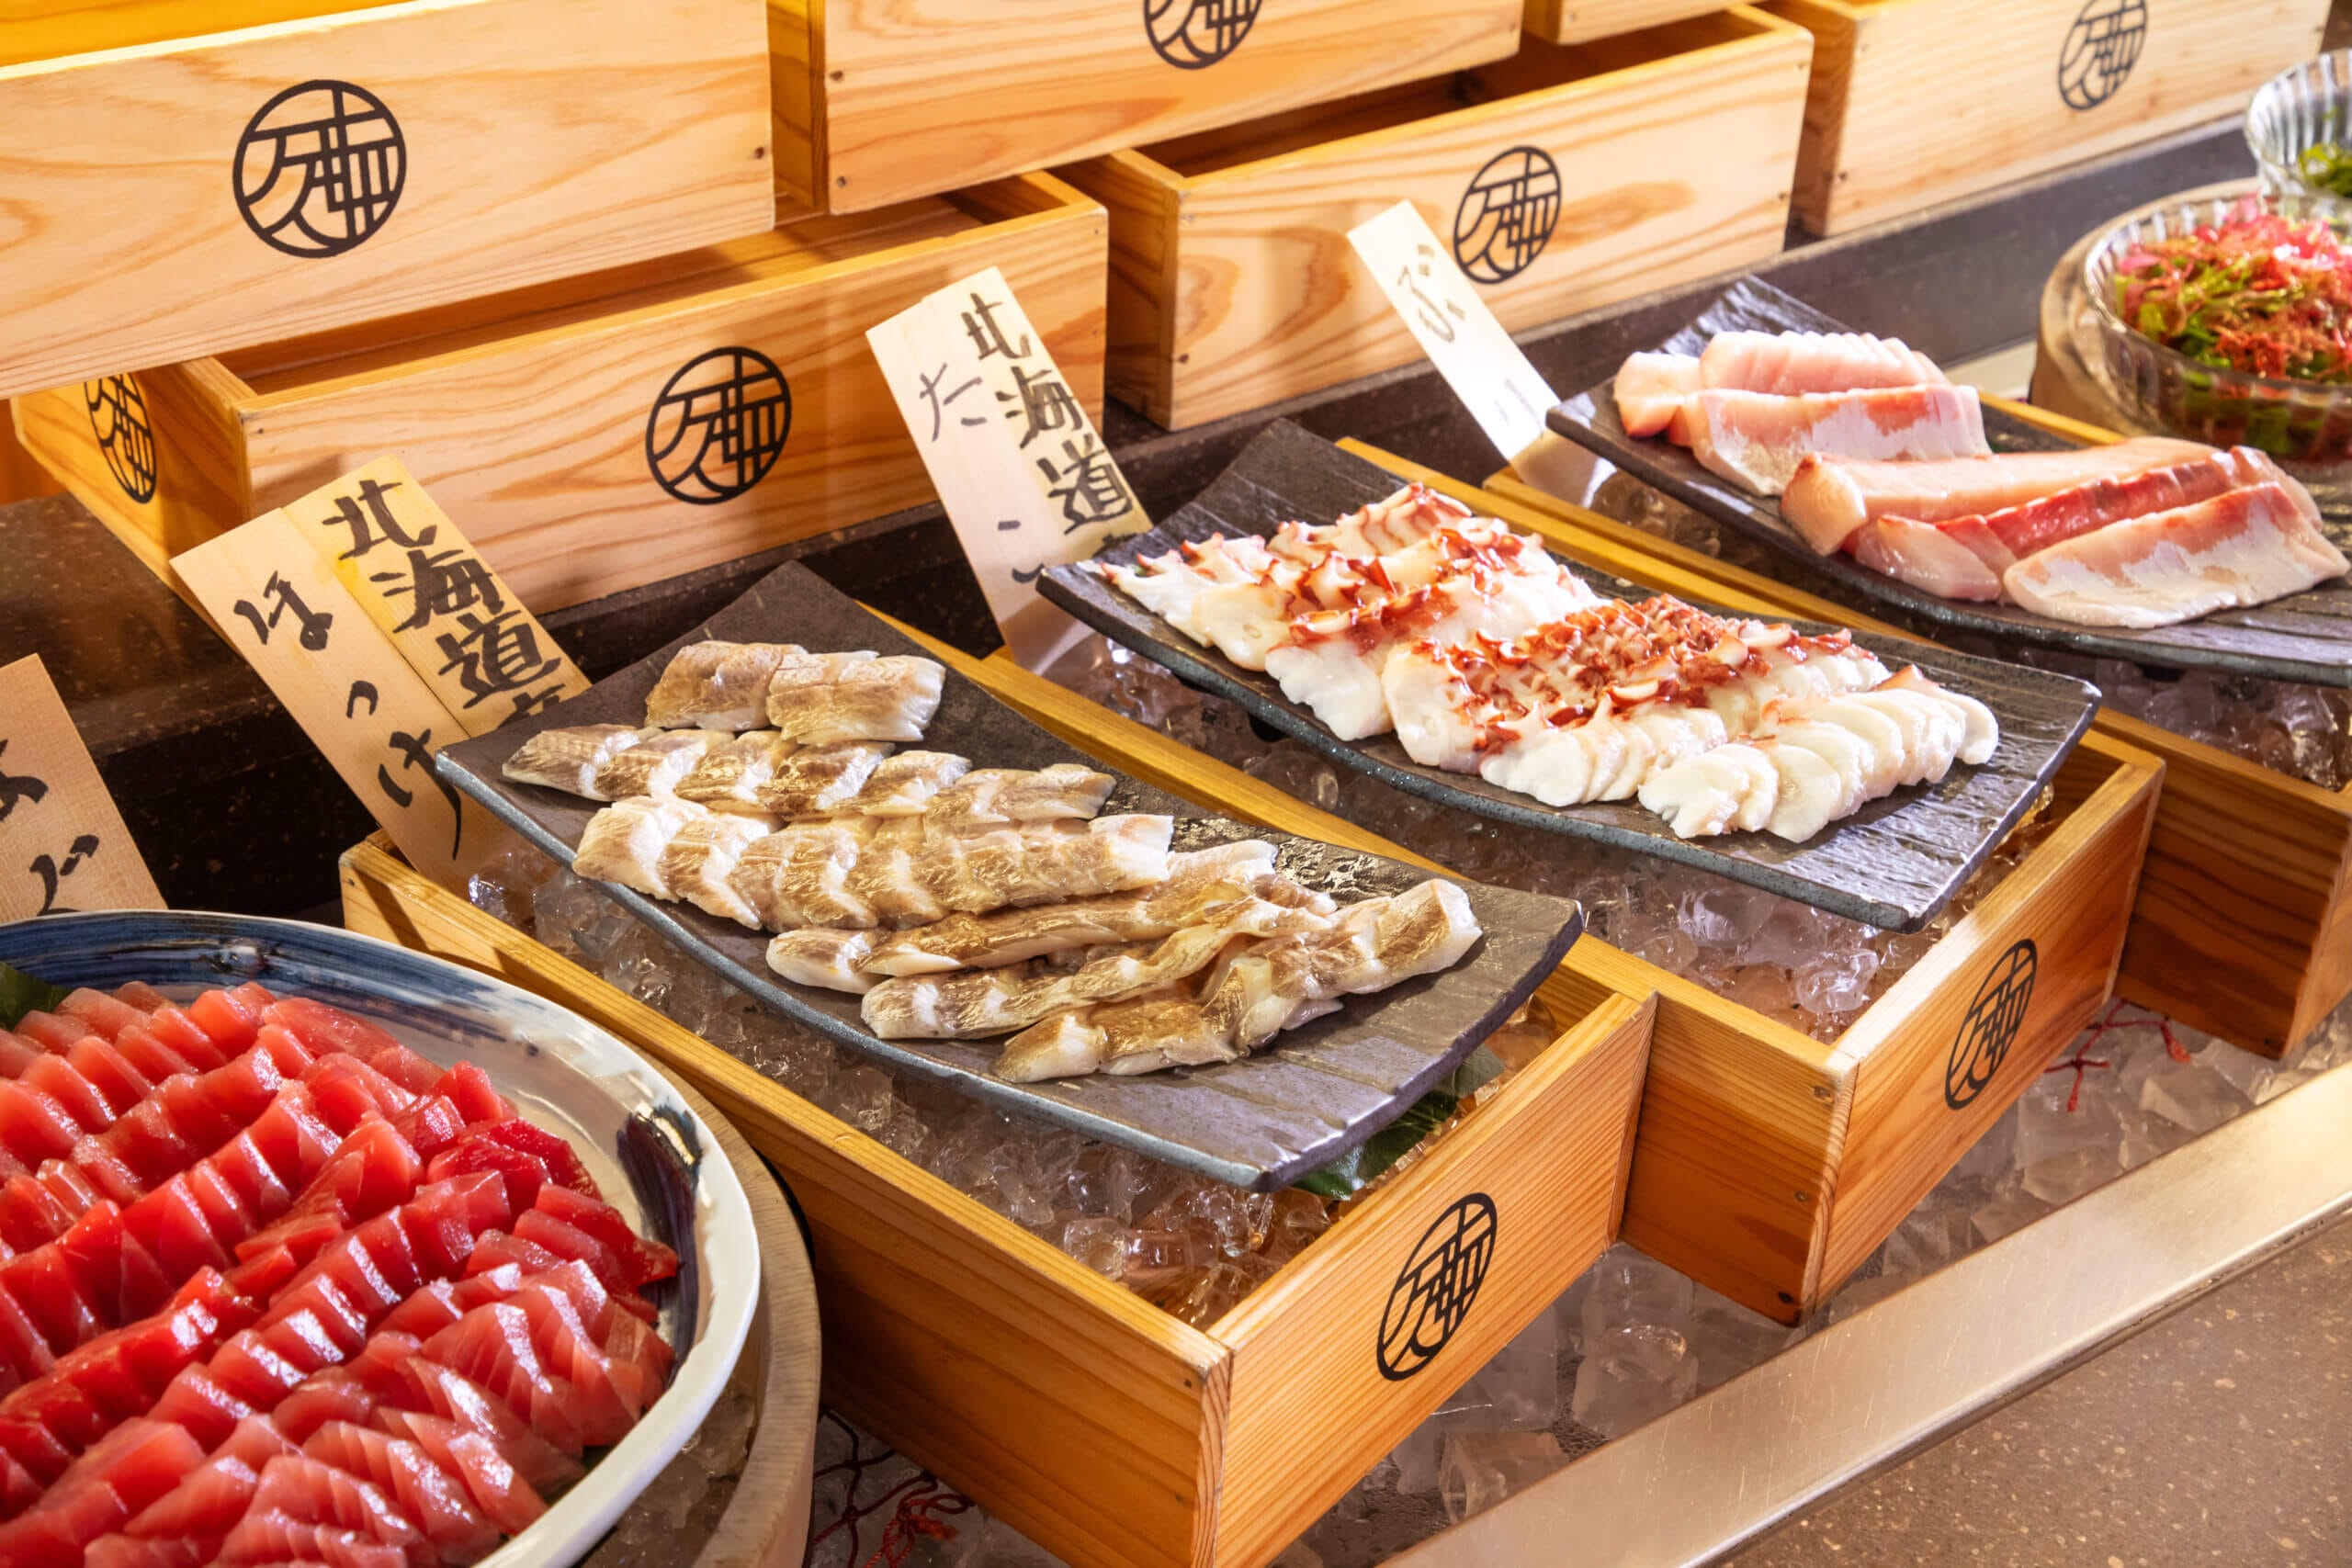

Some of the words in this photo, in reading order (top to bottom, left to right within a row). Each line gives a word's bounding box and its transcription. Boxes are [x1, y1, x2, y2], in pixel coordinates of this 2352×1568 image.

[960, 292, 1155, 554] 北海道
[233, 570, 461, 861] ほっけ
